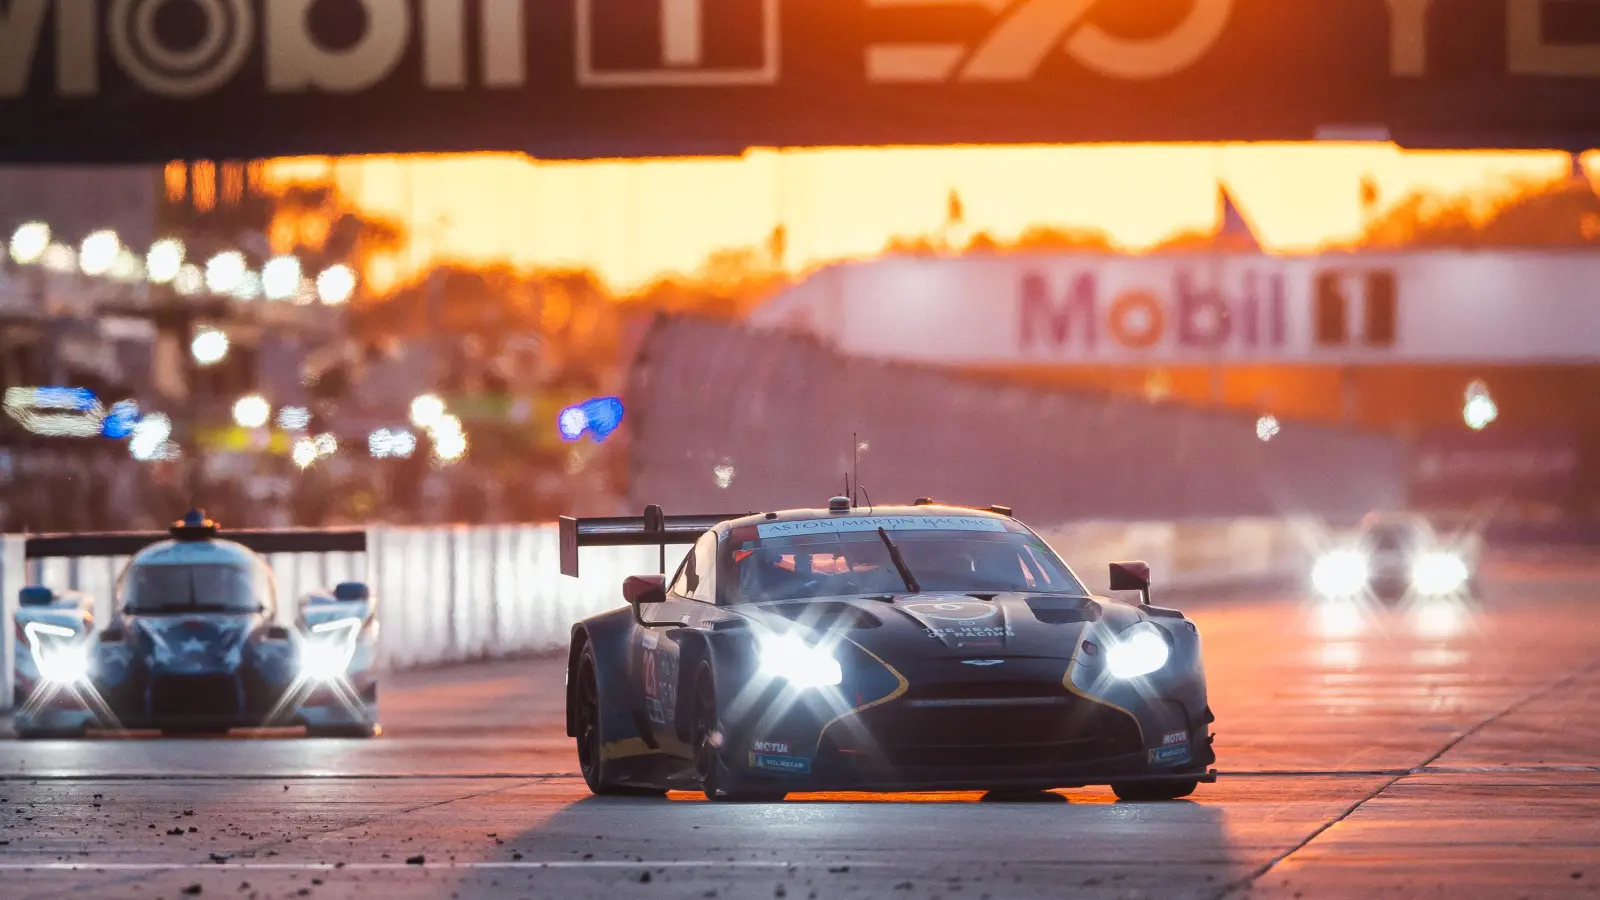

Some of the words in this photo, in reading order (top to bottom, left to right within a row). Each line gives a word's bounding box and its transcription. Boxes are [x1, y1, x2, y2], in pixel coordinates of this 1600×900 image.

[1018, 270, 1287, 349] Mobil
[769, 521, 833, 533] ASTON
[842, 518, 915, 527] MARTIN
[923, 517, 995, 527] RACING
